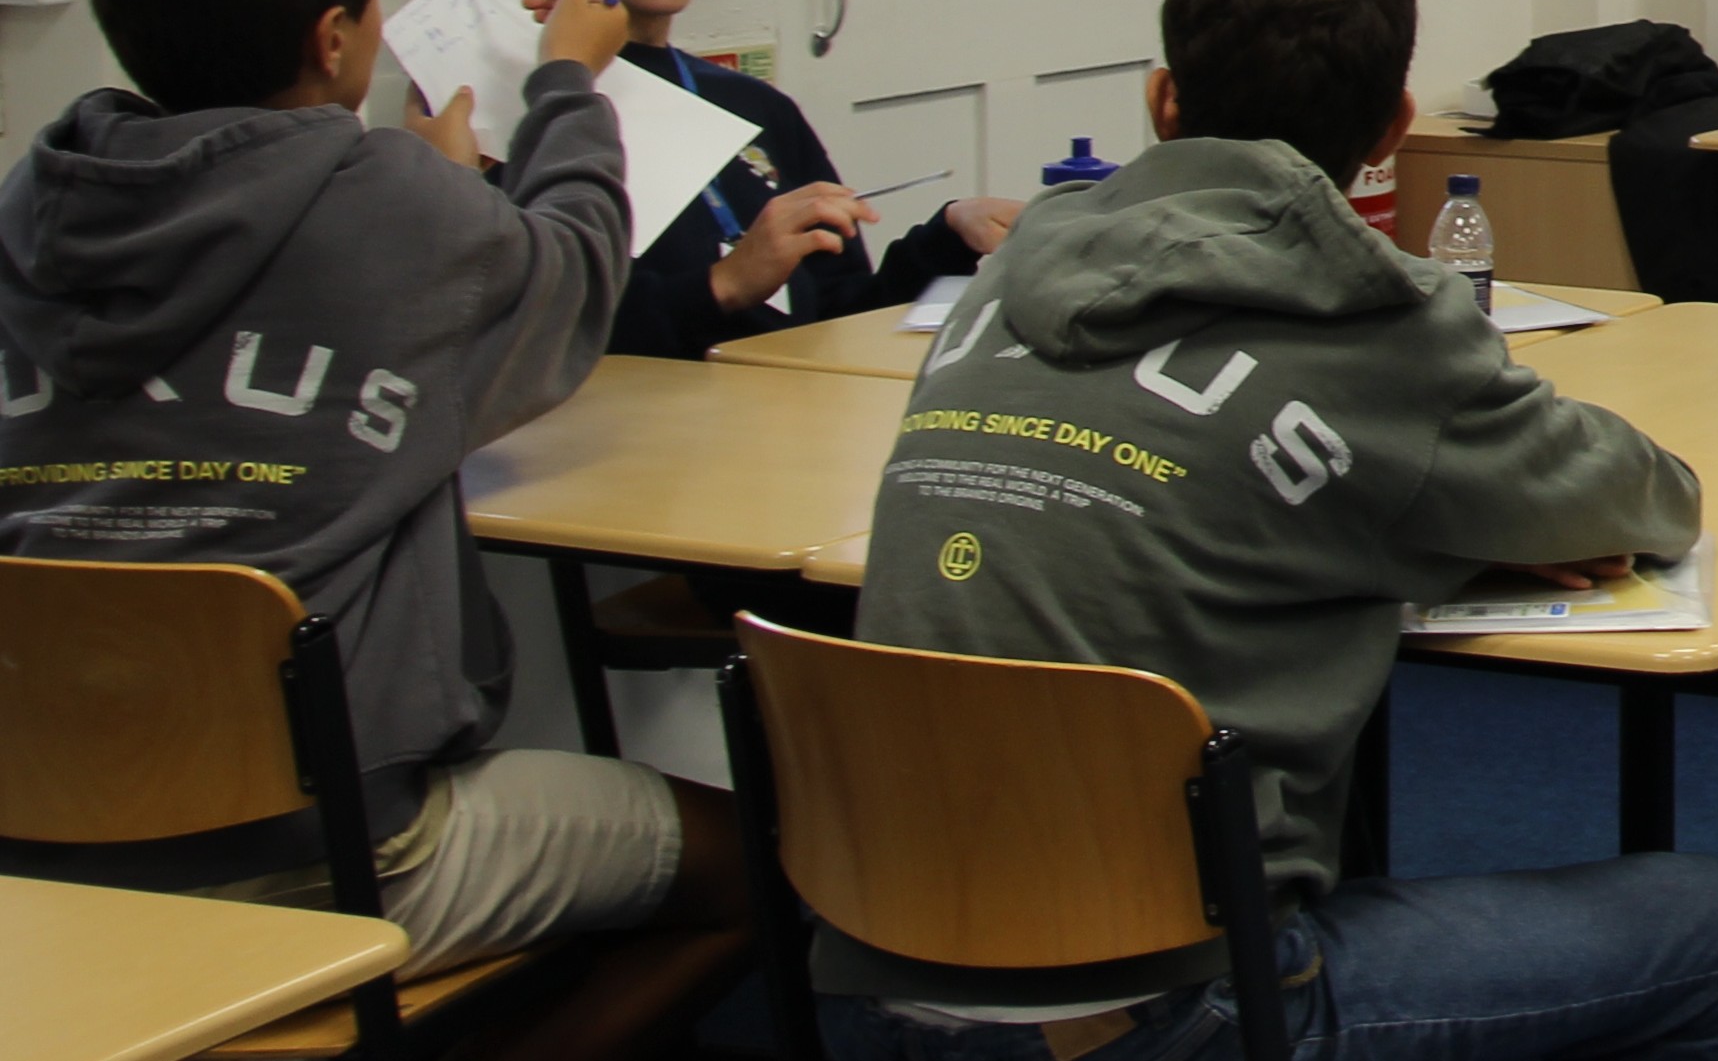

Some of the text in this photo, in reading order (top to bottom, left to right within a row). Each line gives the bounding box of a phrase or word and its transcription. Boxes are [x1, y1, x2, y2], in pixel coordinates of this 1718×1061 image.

[982, 413, 1053, 440] SINCE
[1054, 423, 1113, 453] DAY
[110, 460, 174, 480] SINCE
[178, 461, 231, 480] DAY
